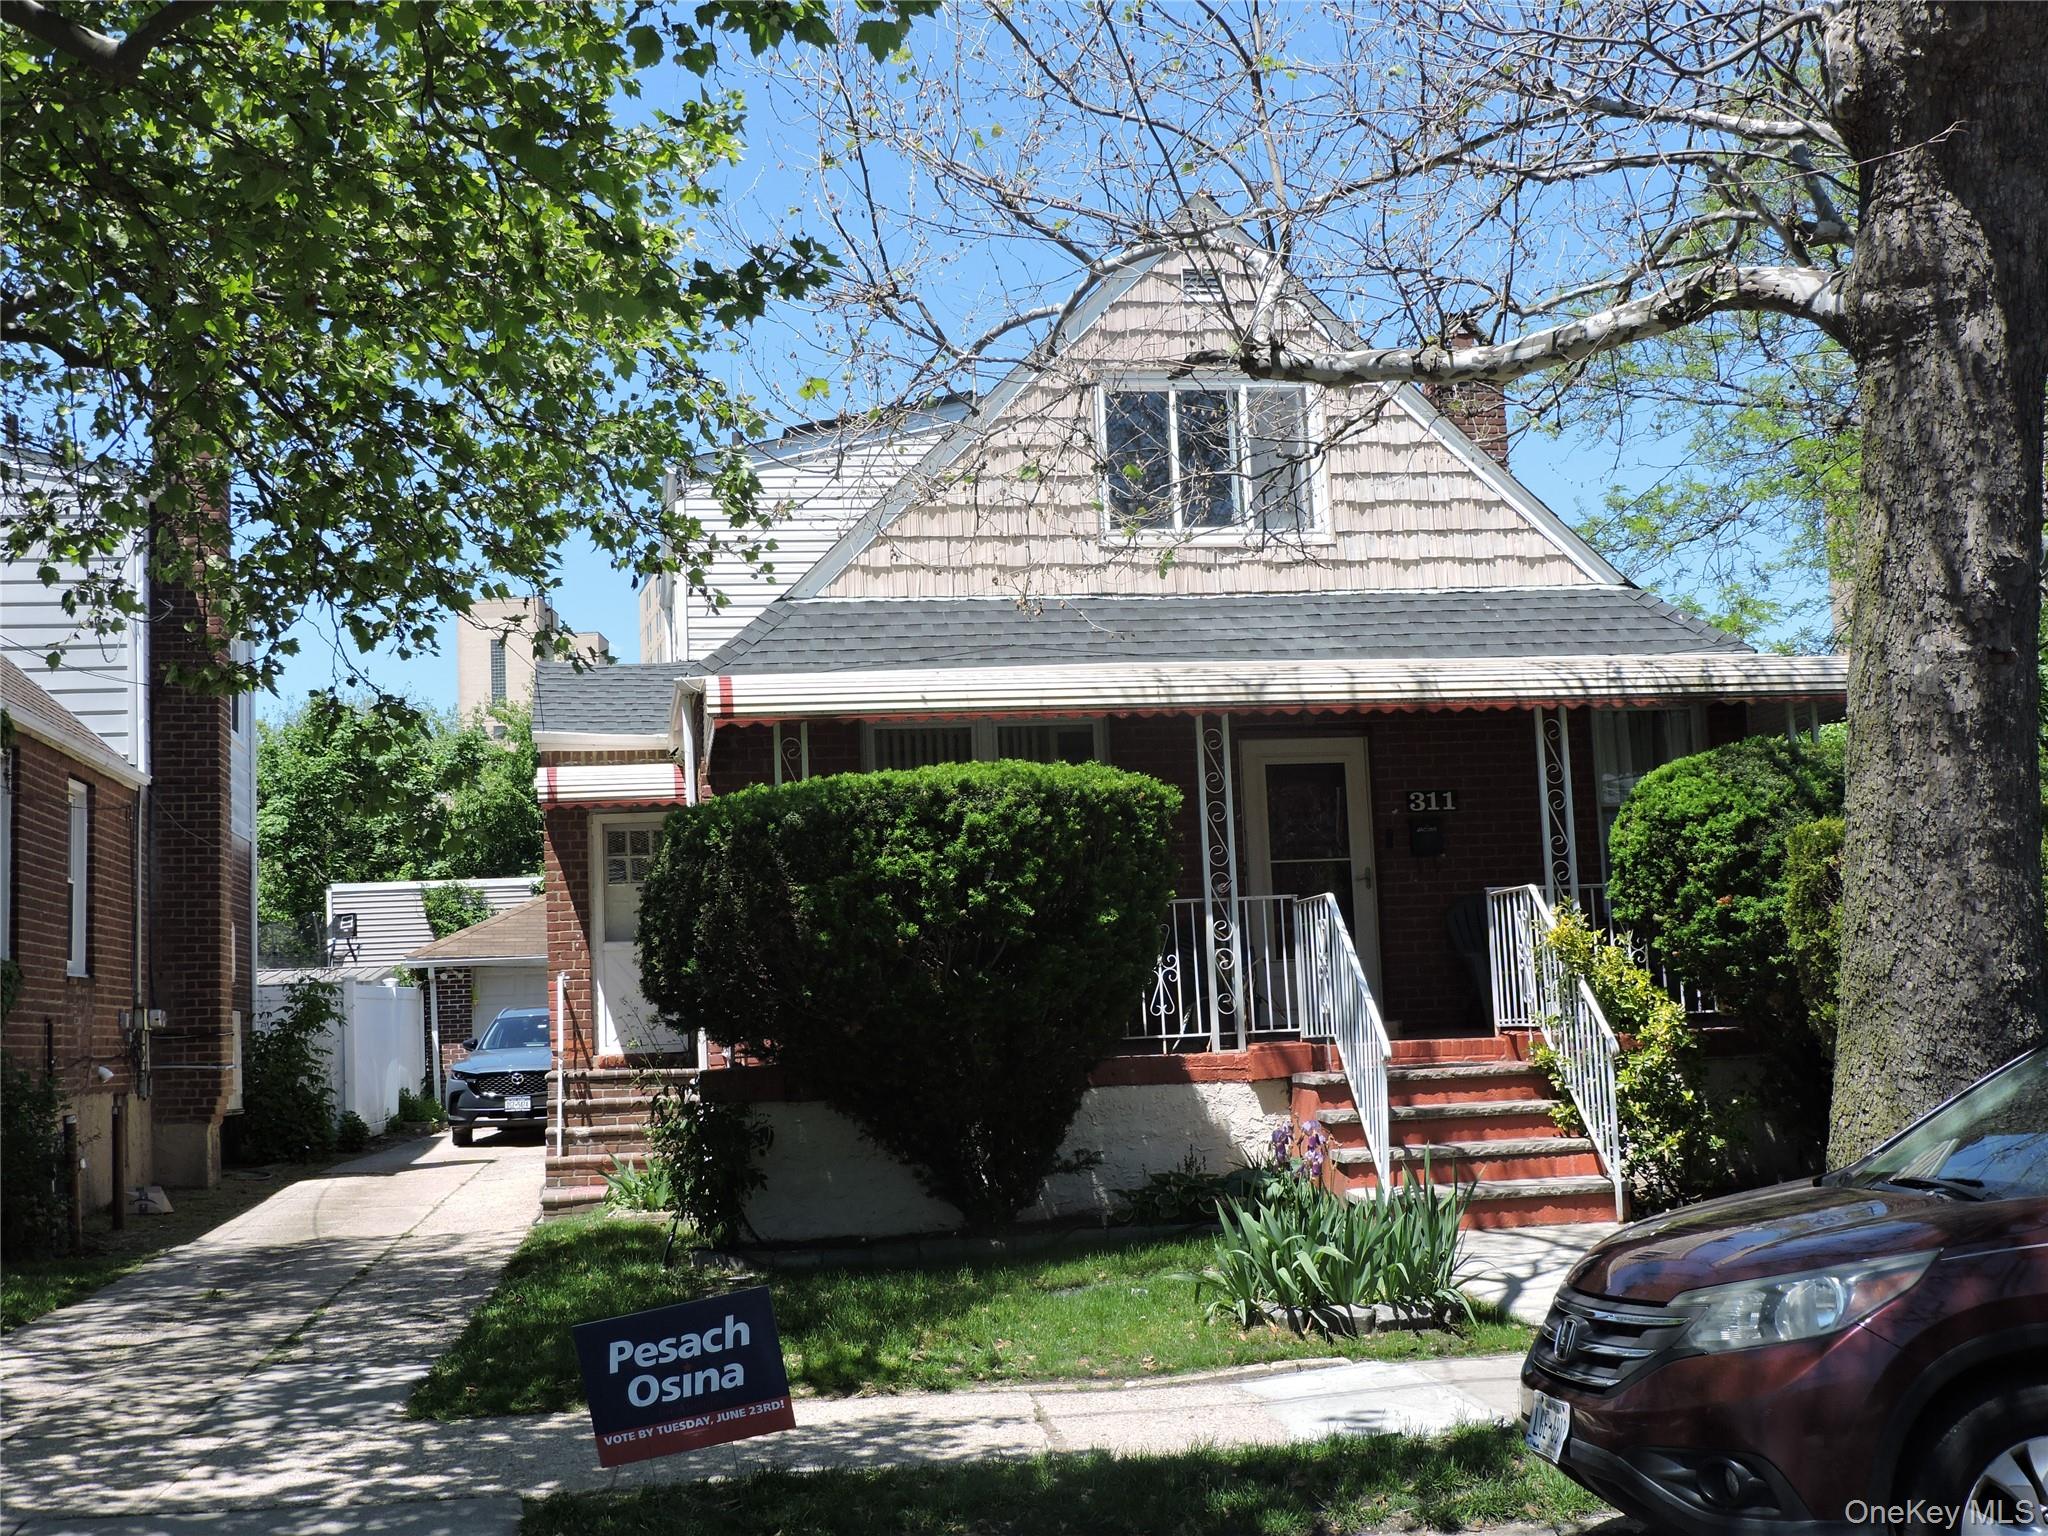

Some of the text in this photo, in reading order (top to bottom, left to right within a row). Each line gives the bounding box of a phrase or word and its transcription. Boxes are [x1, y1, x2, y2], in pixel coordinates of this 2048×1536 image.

[1409, 791, 1457, 811] 311
[608, 1314, 750, 1375] Pesach
[627, 1361, 745, 1408] Osina
[604, 1432, 636, 1446] VOTE
[638, 1428, 654, 1440] BY
[656, 1415, 715, 1435] TUESDAY,
[716, 1408, 747, 1423] JUNE
[749, 1399, 785, 1416] 23RD!
